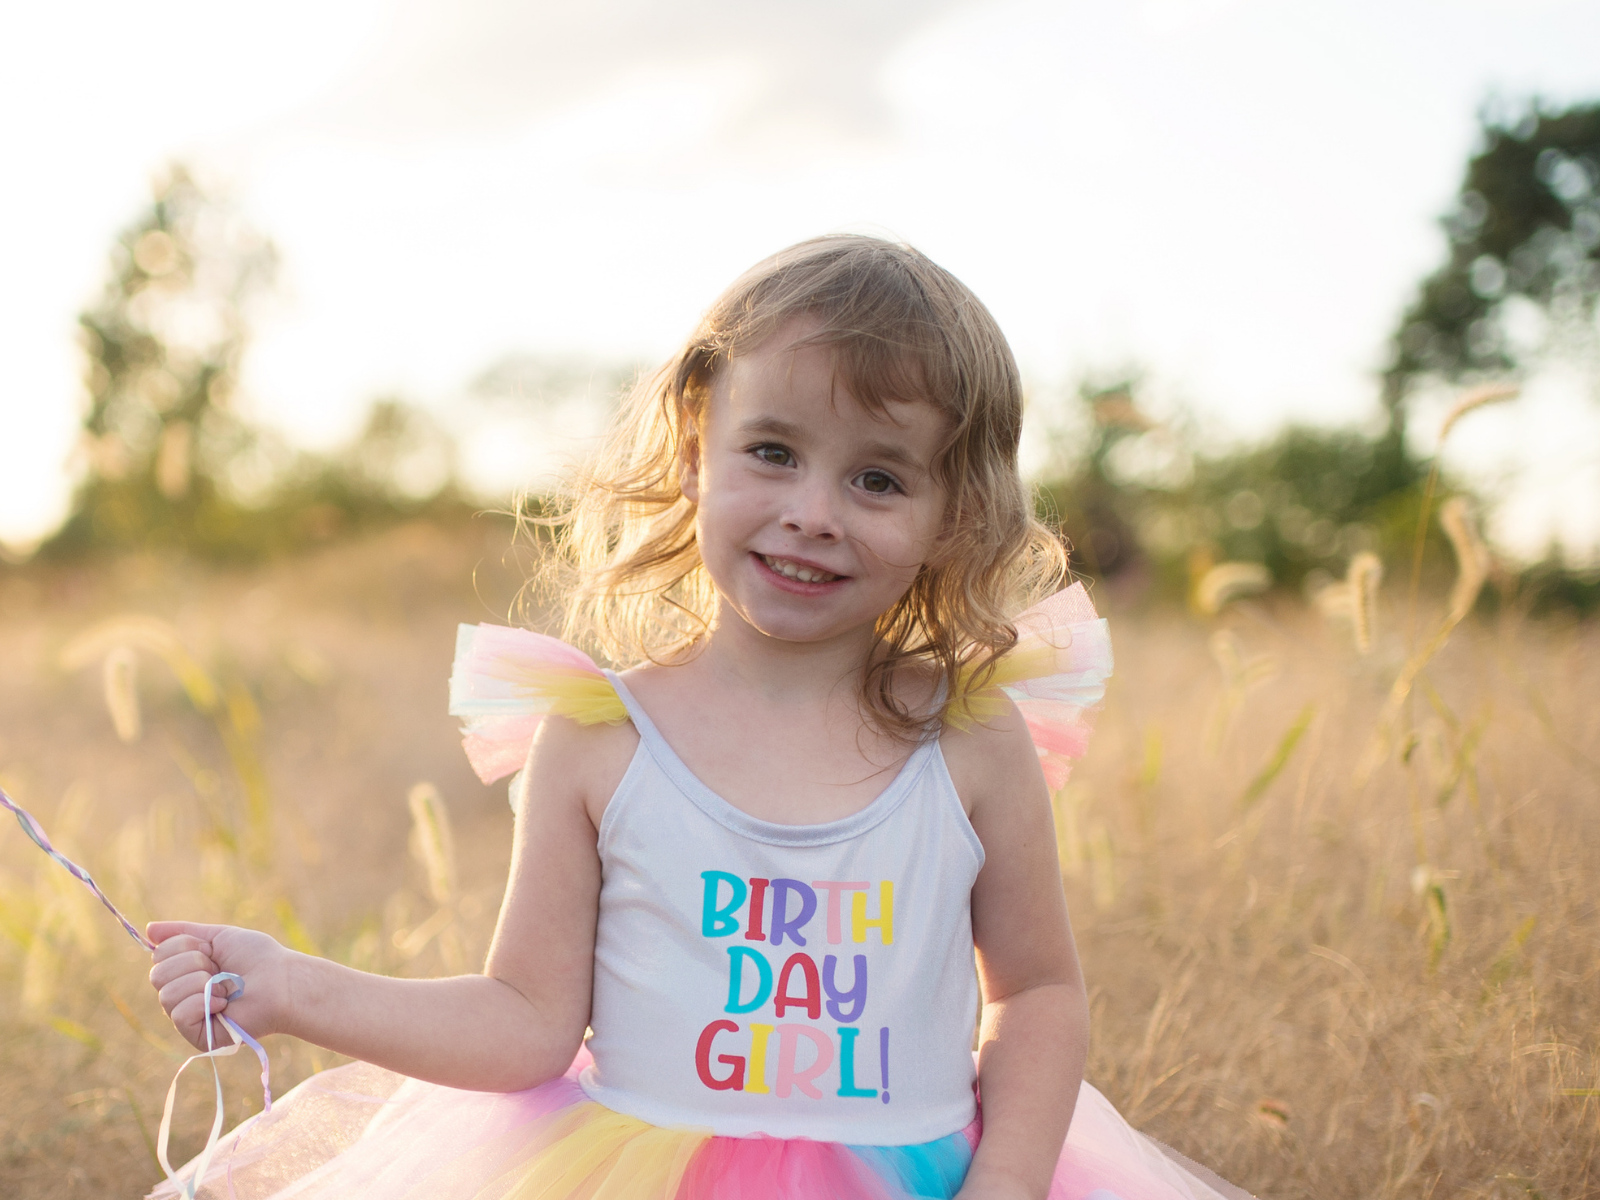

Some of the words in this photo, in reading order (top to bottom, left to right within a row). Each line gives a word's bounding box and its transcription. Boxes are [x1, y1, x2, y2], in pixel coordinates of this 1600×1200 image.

[700, 870, 894, 946] BIRTH
[724, 945, 868, 1023] DAY
[695, 1019, 891, 1105] GIRL!
